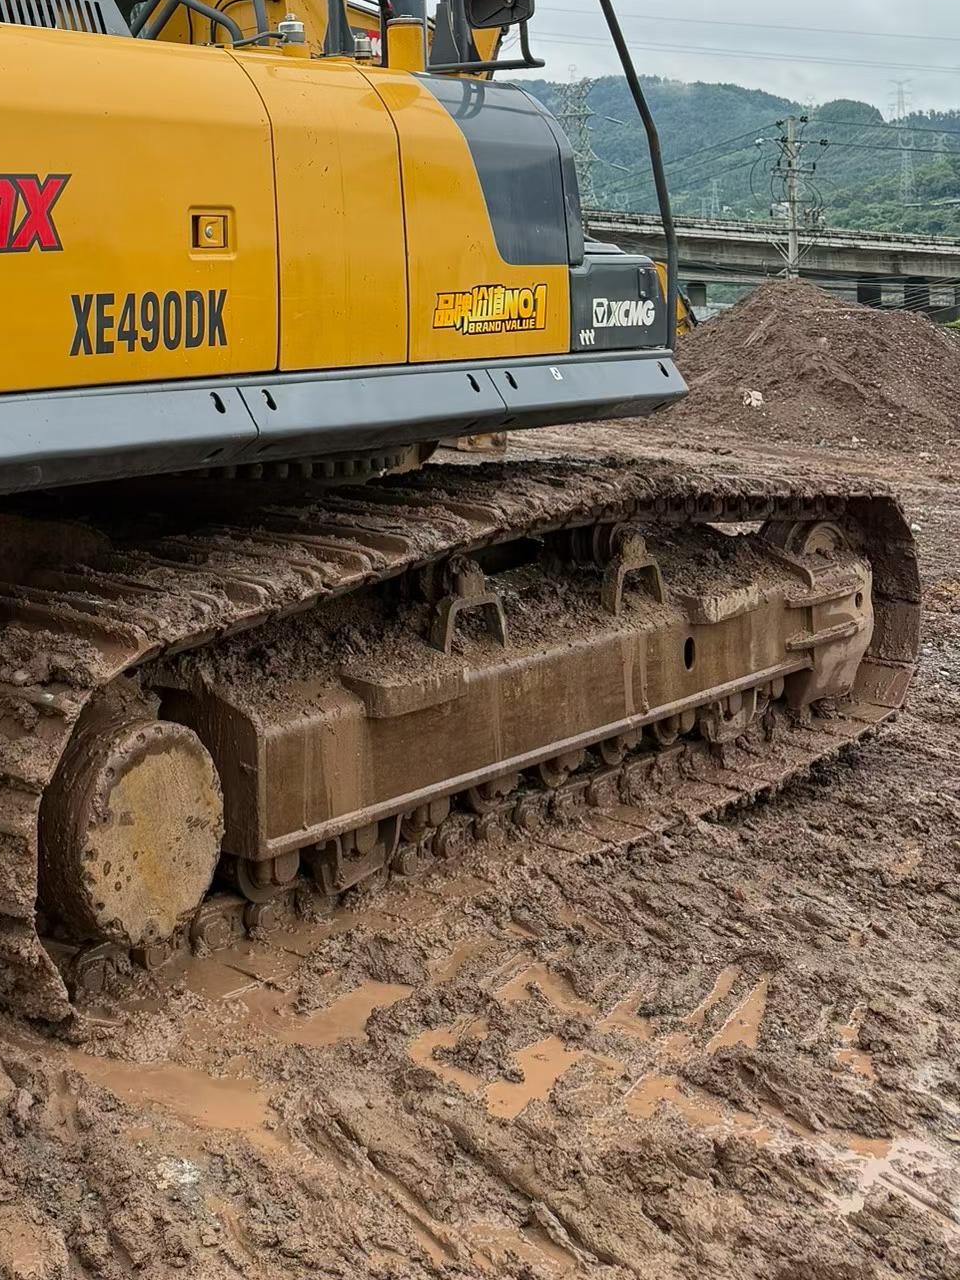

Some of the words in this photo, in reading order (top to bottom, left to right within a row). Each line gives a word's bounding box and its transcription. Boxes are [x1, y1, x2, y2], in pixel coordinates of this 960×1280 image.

[69, 288, 228, 357] XE490DK
[468, 320, 501, 333] BRAND
[505, 318, 536, 331] VALUE
[607, 300, 655, 327] XCMG
